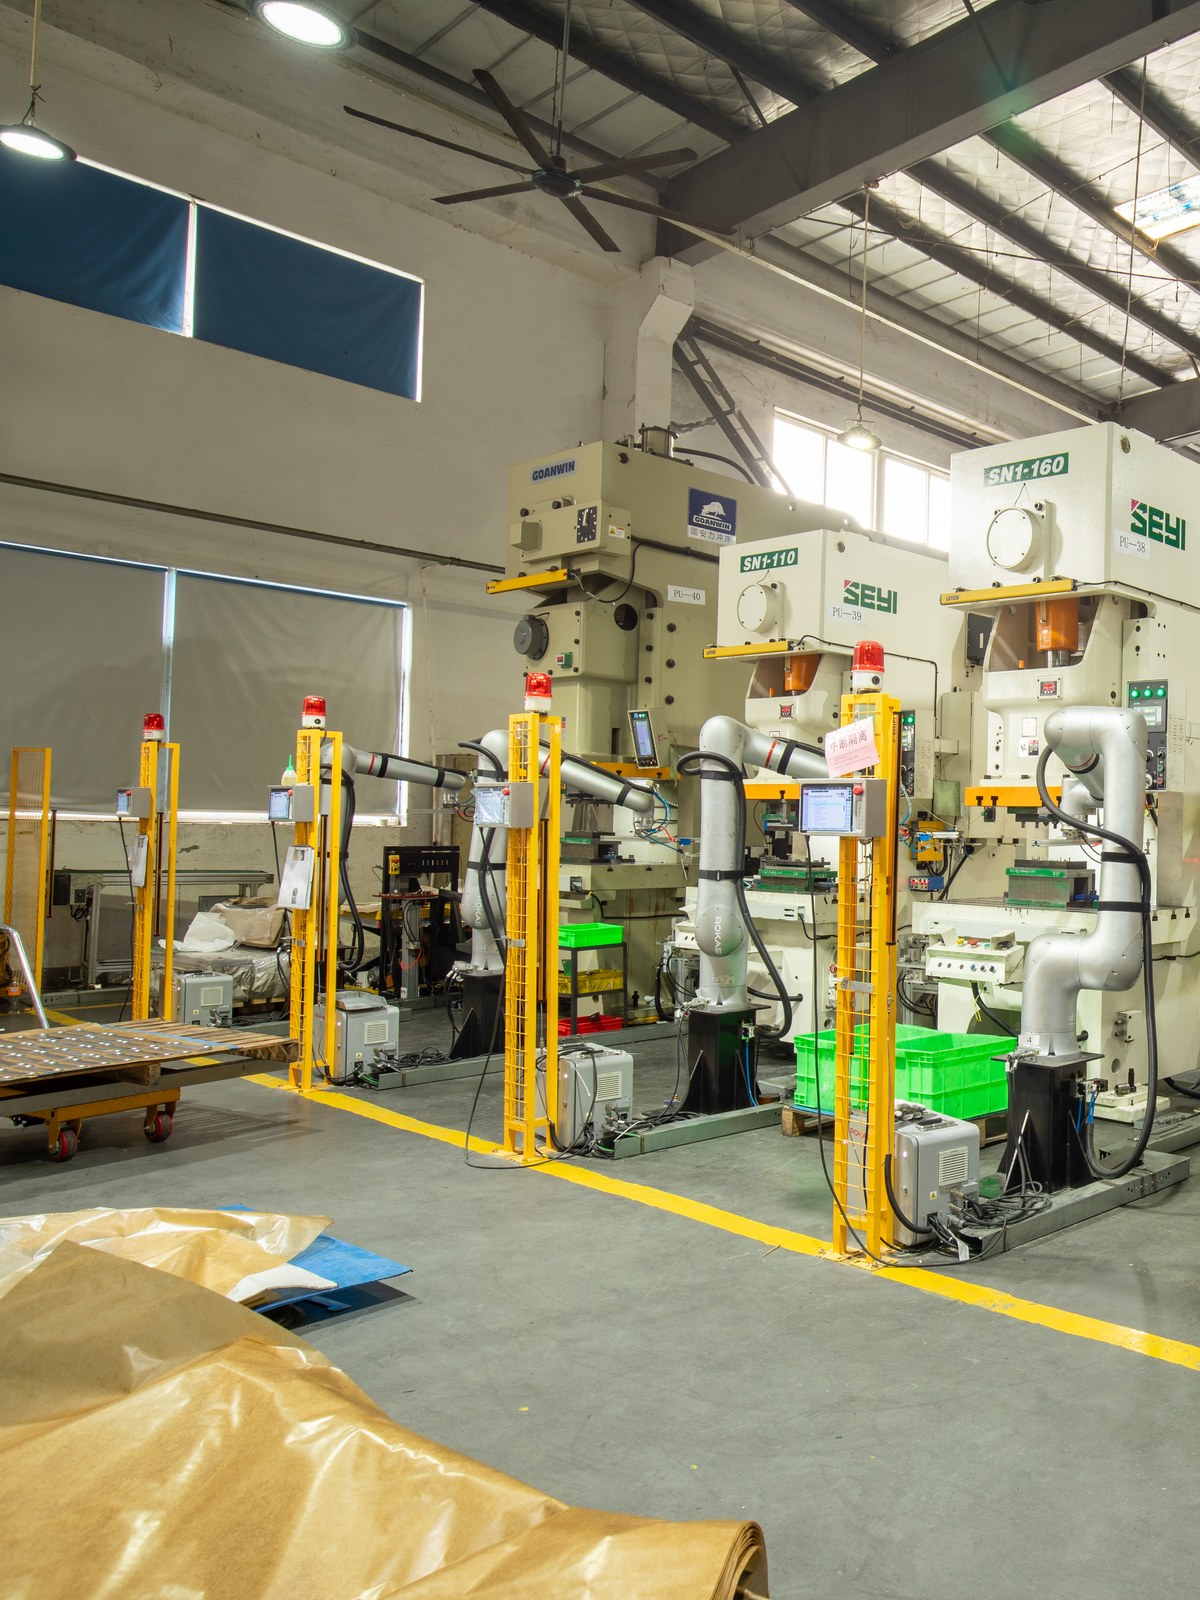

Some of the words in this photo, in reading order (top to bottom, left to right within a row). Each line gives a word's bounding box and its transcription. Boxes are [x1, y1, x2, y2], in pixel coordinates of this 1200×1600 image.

[532, 460, 576, 481] GOANWIN
[988, 456, 1065, 484] SN1-160
[694, 516, 732, 531] GOANWIN
[1130, 498, 1186, 551] SEYI
[743, 550, 796, 571] SN1-110
[843, 579, 898, 614] SEYI
[714, 916, 722, 955] ROKAE
